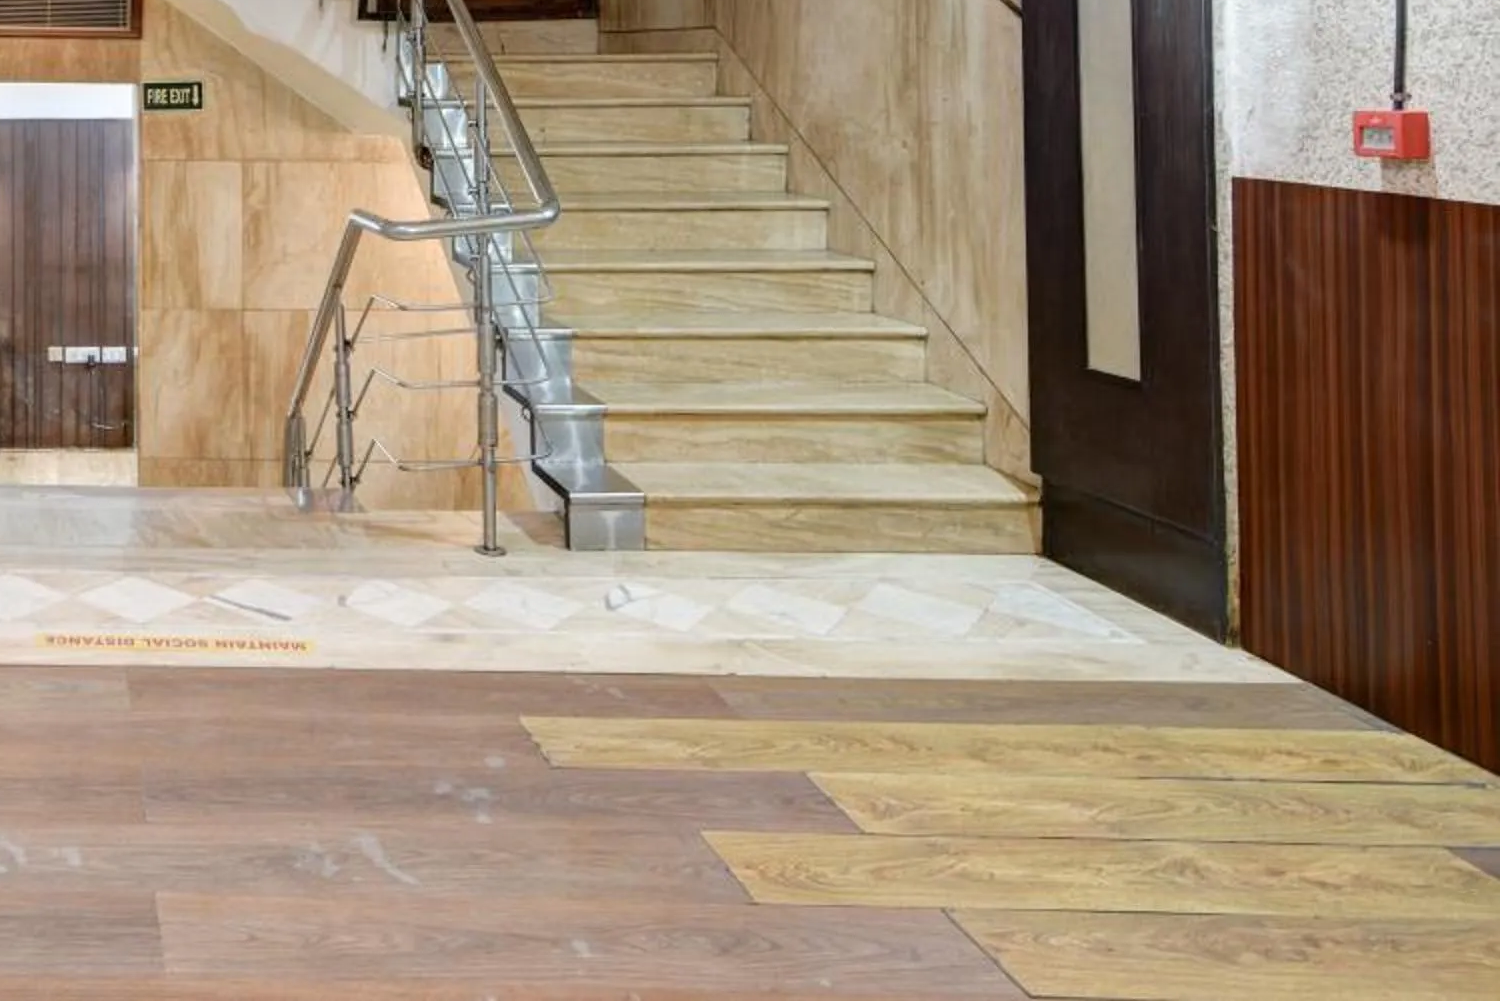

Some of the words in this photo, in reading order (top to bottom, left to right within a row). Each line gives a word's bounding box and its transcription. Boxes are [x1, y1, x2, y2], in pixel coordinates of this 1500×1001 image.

[147, 88, 168, 104] FIRE
[169, 88, 190, 104] EXIT
[45, 634, 135, 647] DISTANCE
[144, 637, 210, 649] SOCIAL
[214, 638, 308, 652] MAINTAIN
